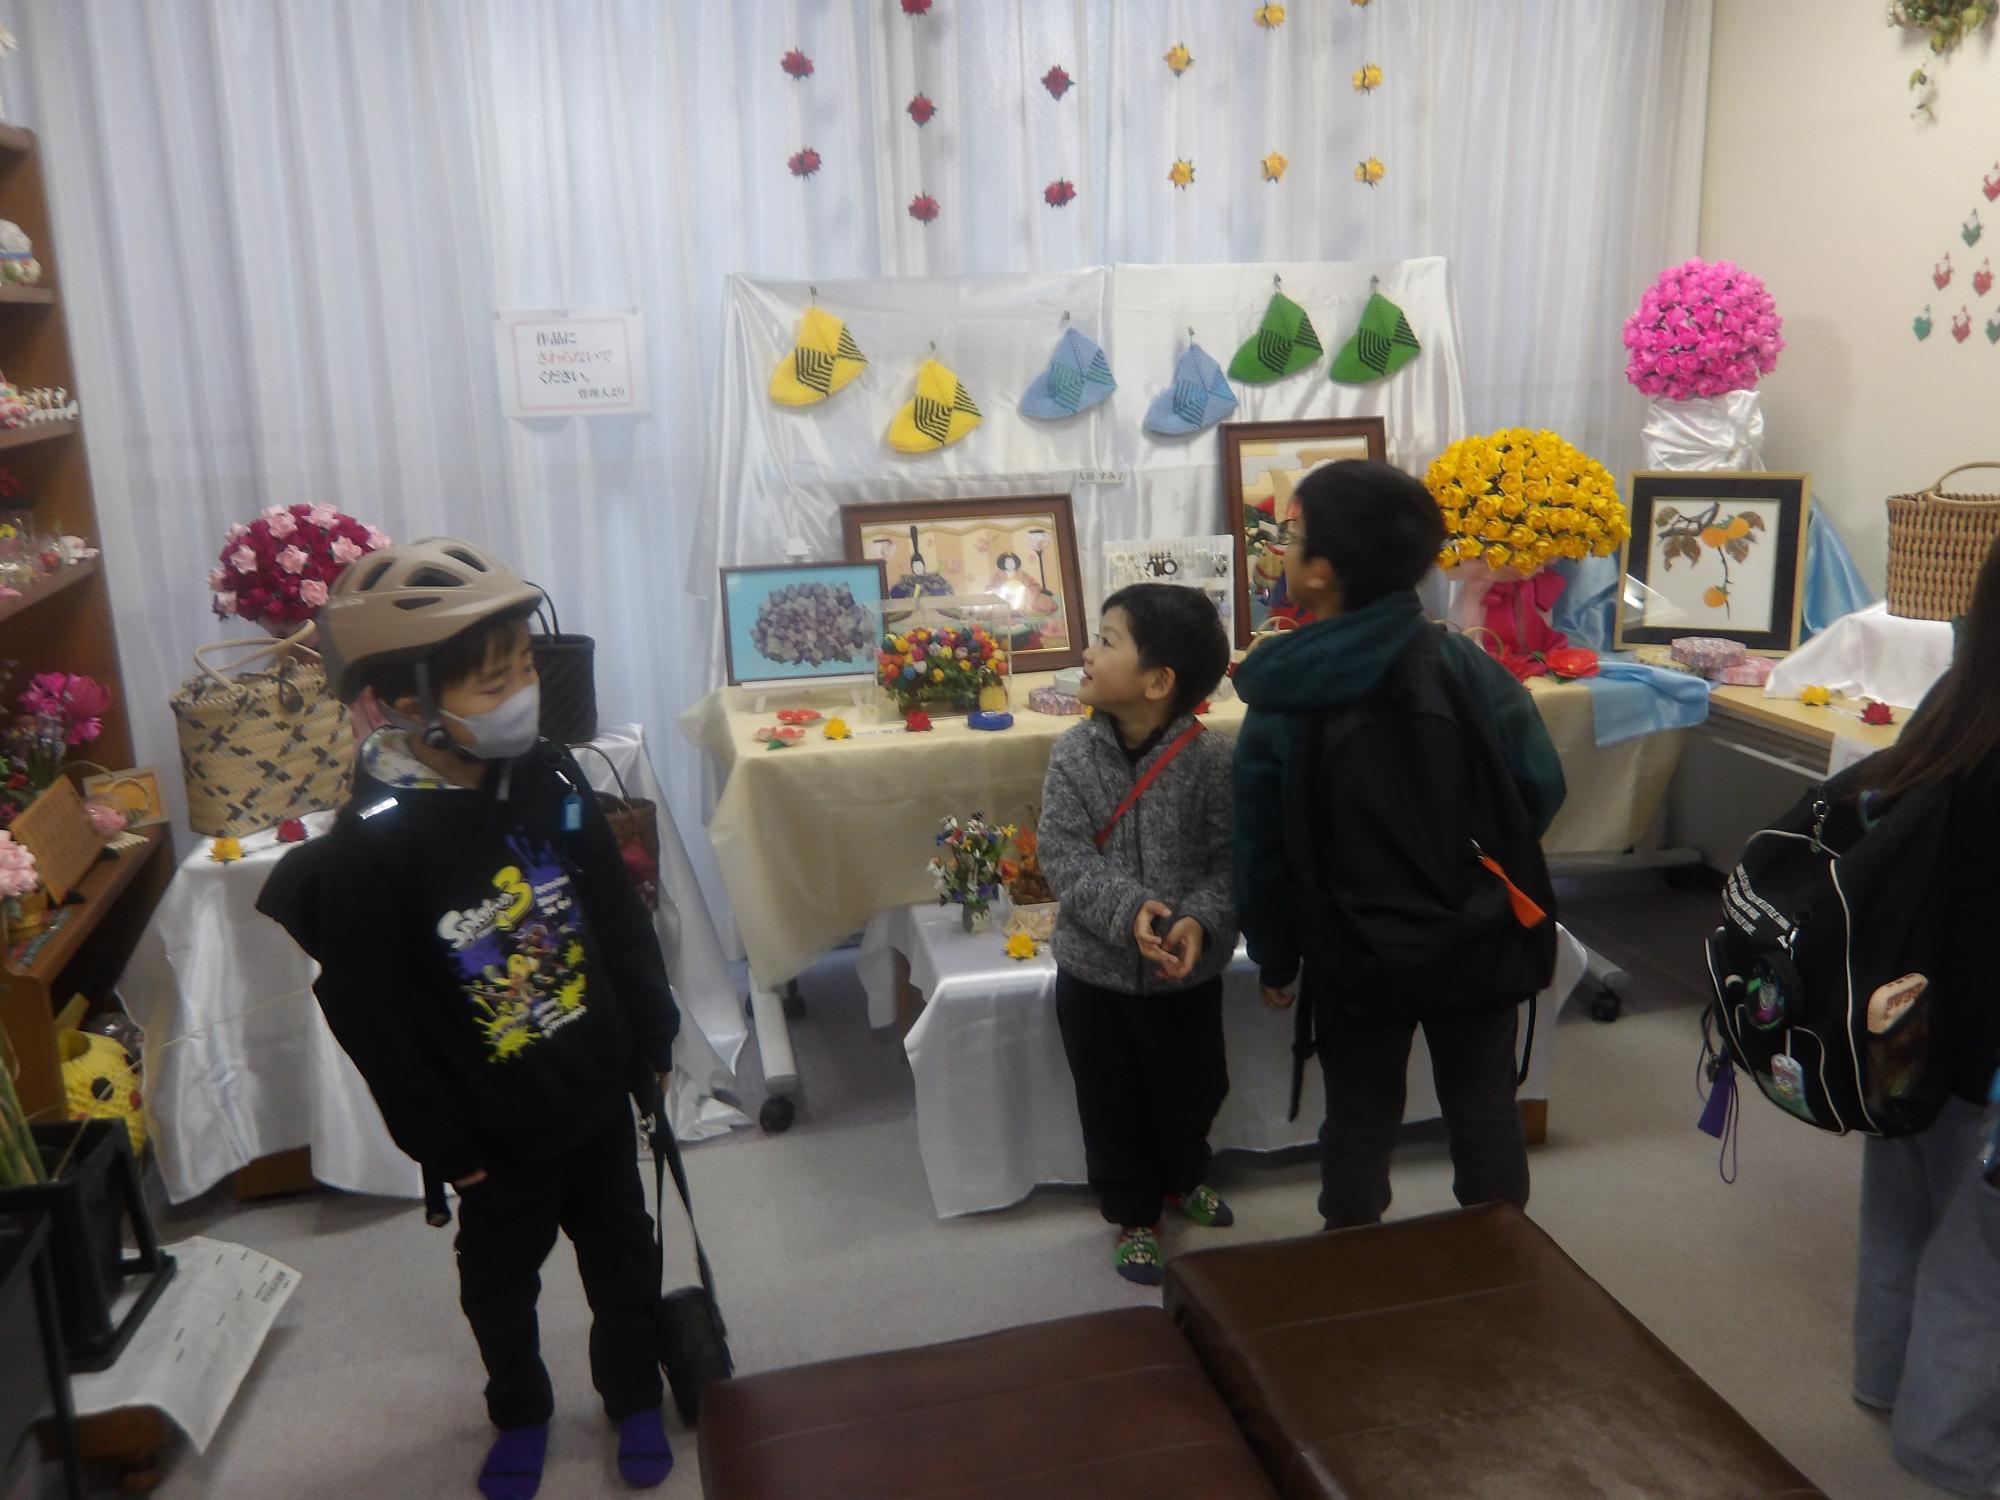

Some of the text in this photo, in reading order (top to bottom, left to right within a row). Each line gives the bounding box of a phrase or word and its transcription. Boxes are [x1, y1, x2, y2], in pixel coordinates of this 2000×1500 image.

[536, 331, 577, 346] 作品に
[537, 350, 613, 365] さわらないで
